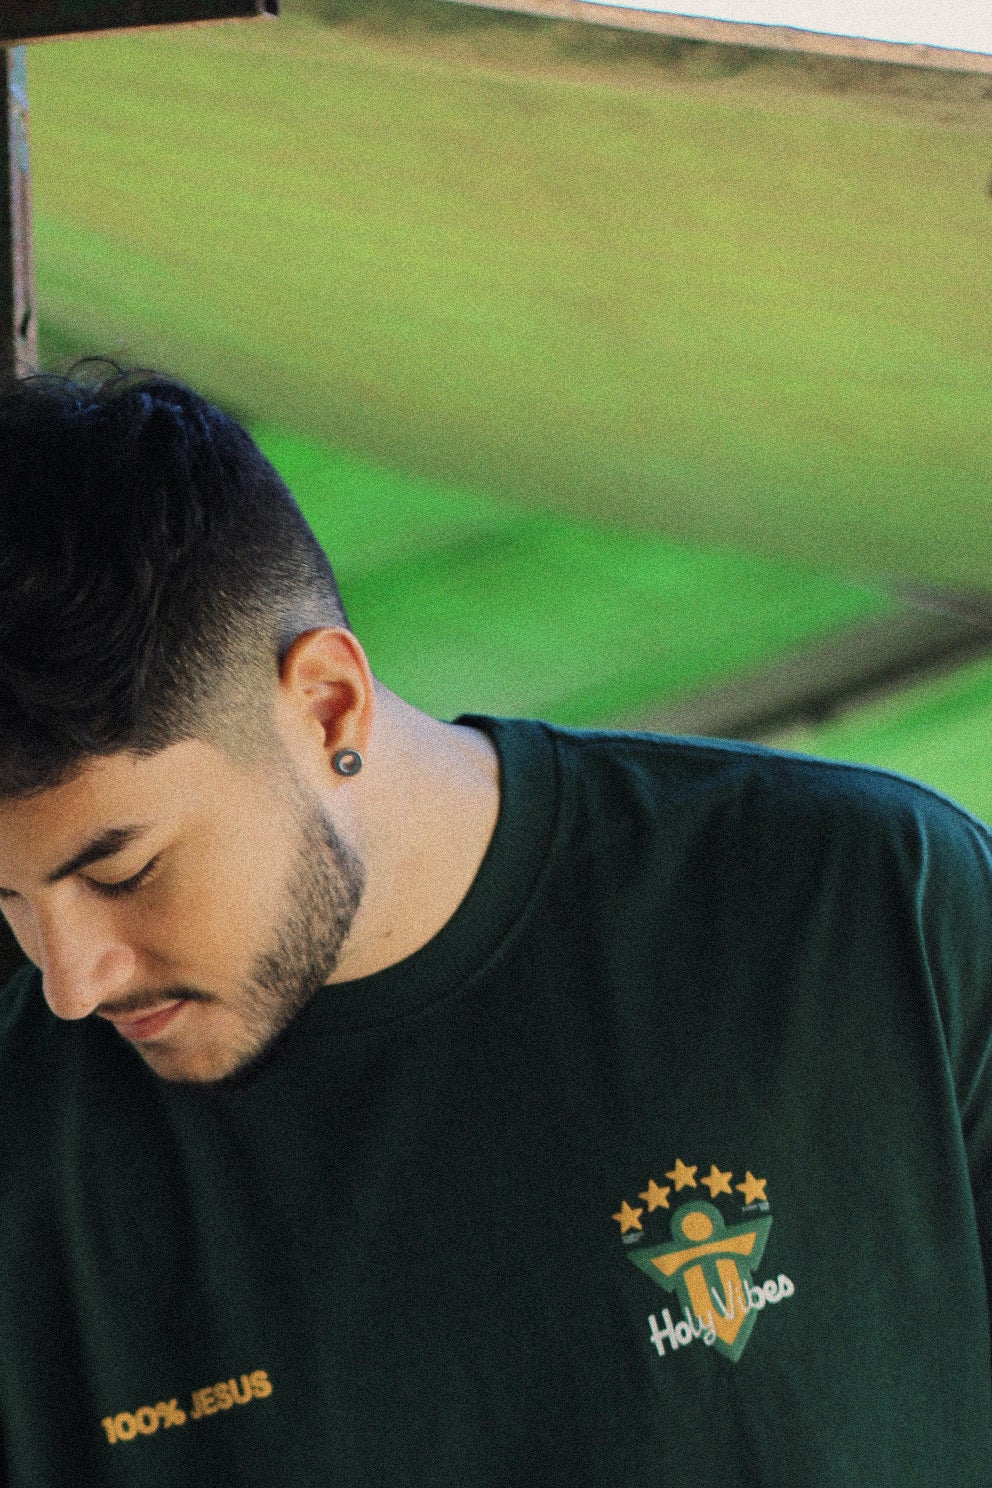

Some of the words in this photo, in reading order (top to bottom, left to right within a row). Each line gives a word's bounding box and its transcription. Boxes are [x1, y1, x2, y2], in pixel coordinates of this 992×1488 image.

[648, 1306, 717, 1357] Holy
[711, 1273, 795, 1321] Vibes
[101, 1398, 187, 1444] 100%
[190, 1369, 273, 1420] JESUS
